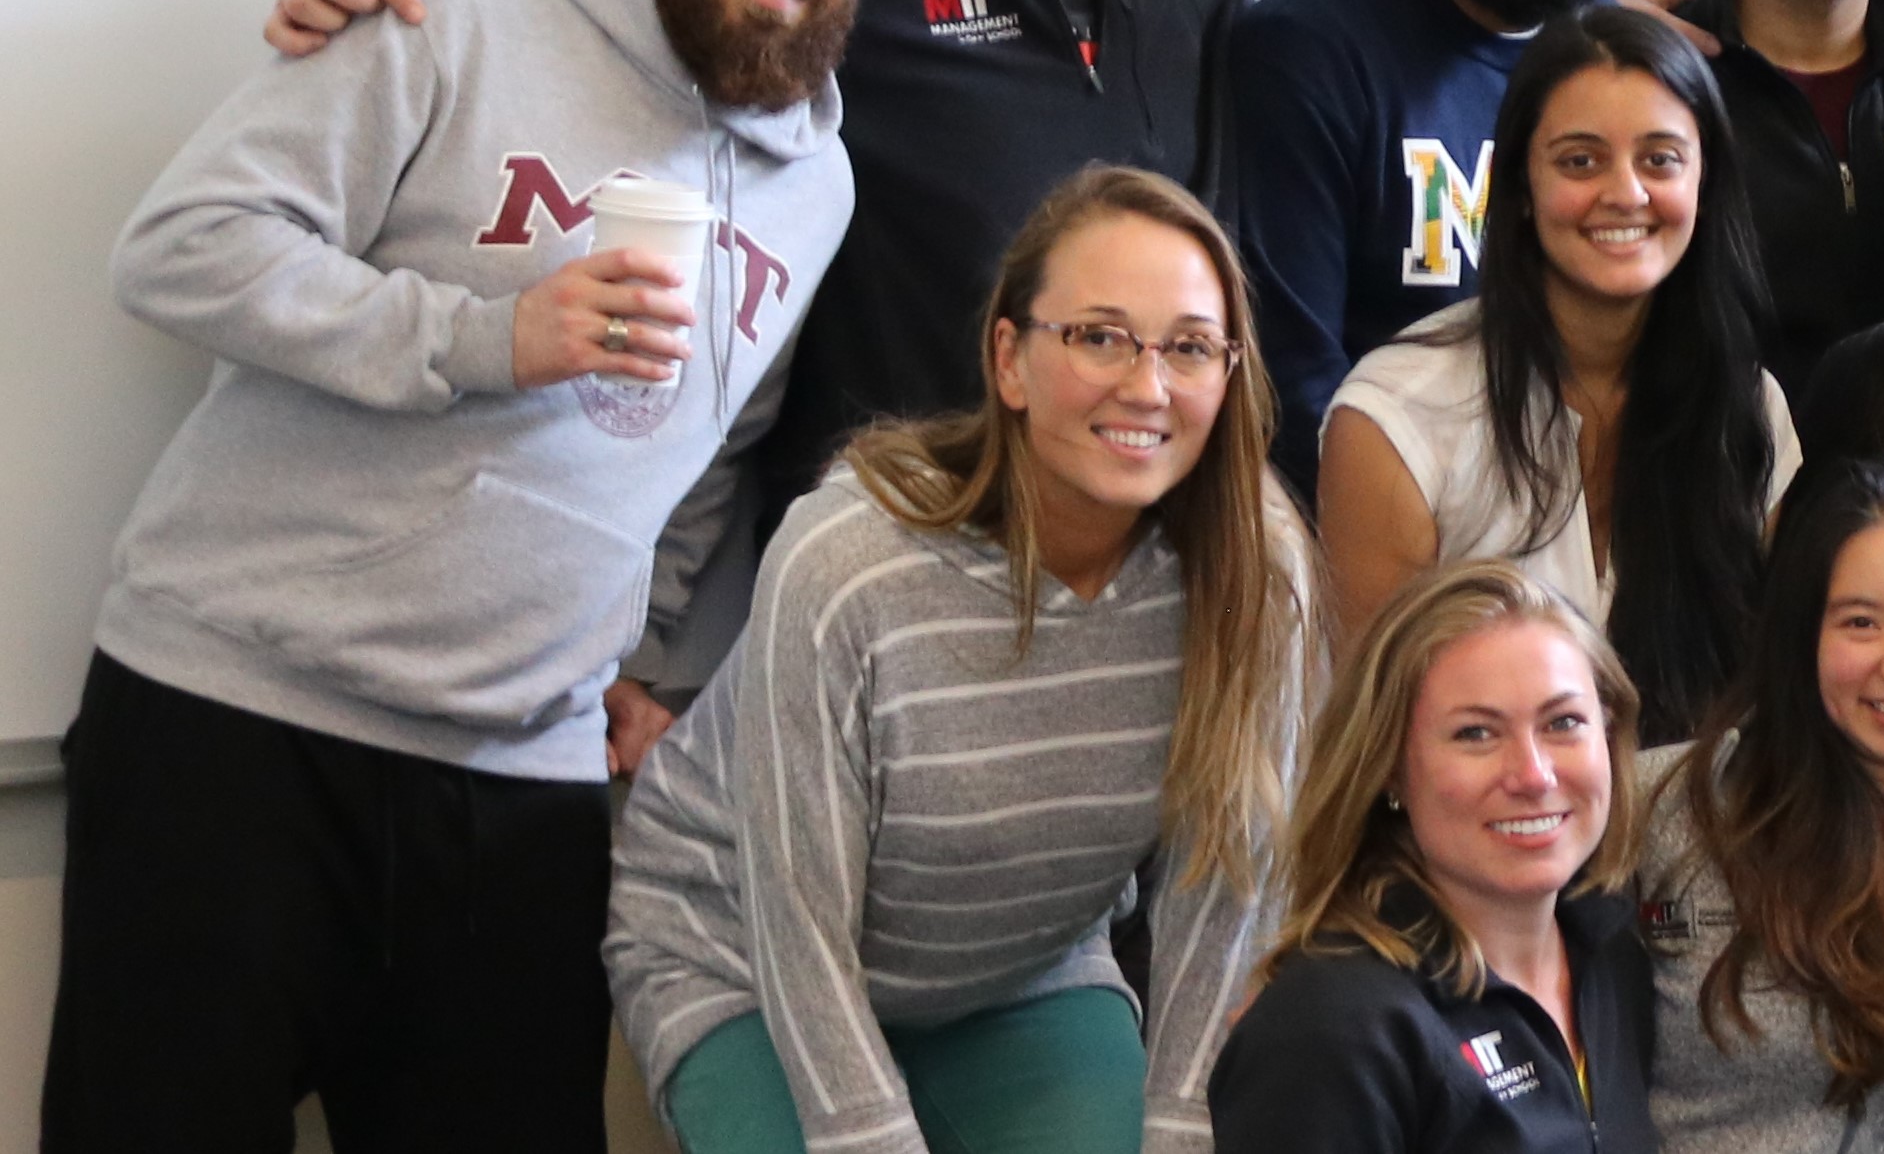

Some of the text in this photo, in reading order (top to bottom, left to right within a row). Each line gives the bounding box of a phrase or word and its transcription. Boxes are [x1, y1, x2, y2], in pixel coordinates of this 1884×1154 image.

[930, 13, 1020, 37] MANAGEMENT
[473, 150, 793, 349] MT
[1460, 1030, 1503, 1079] IT
